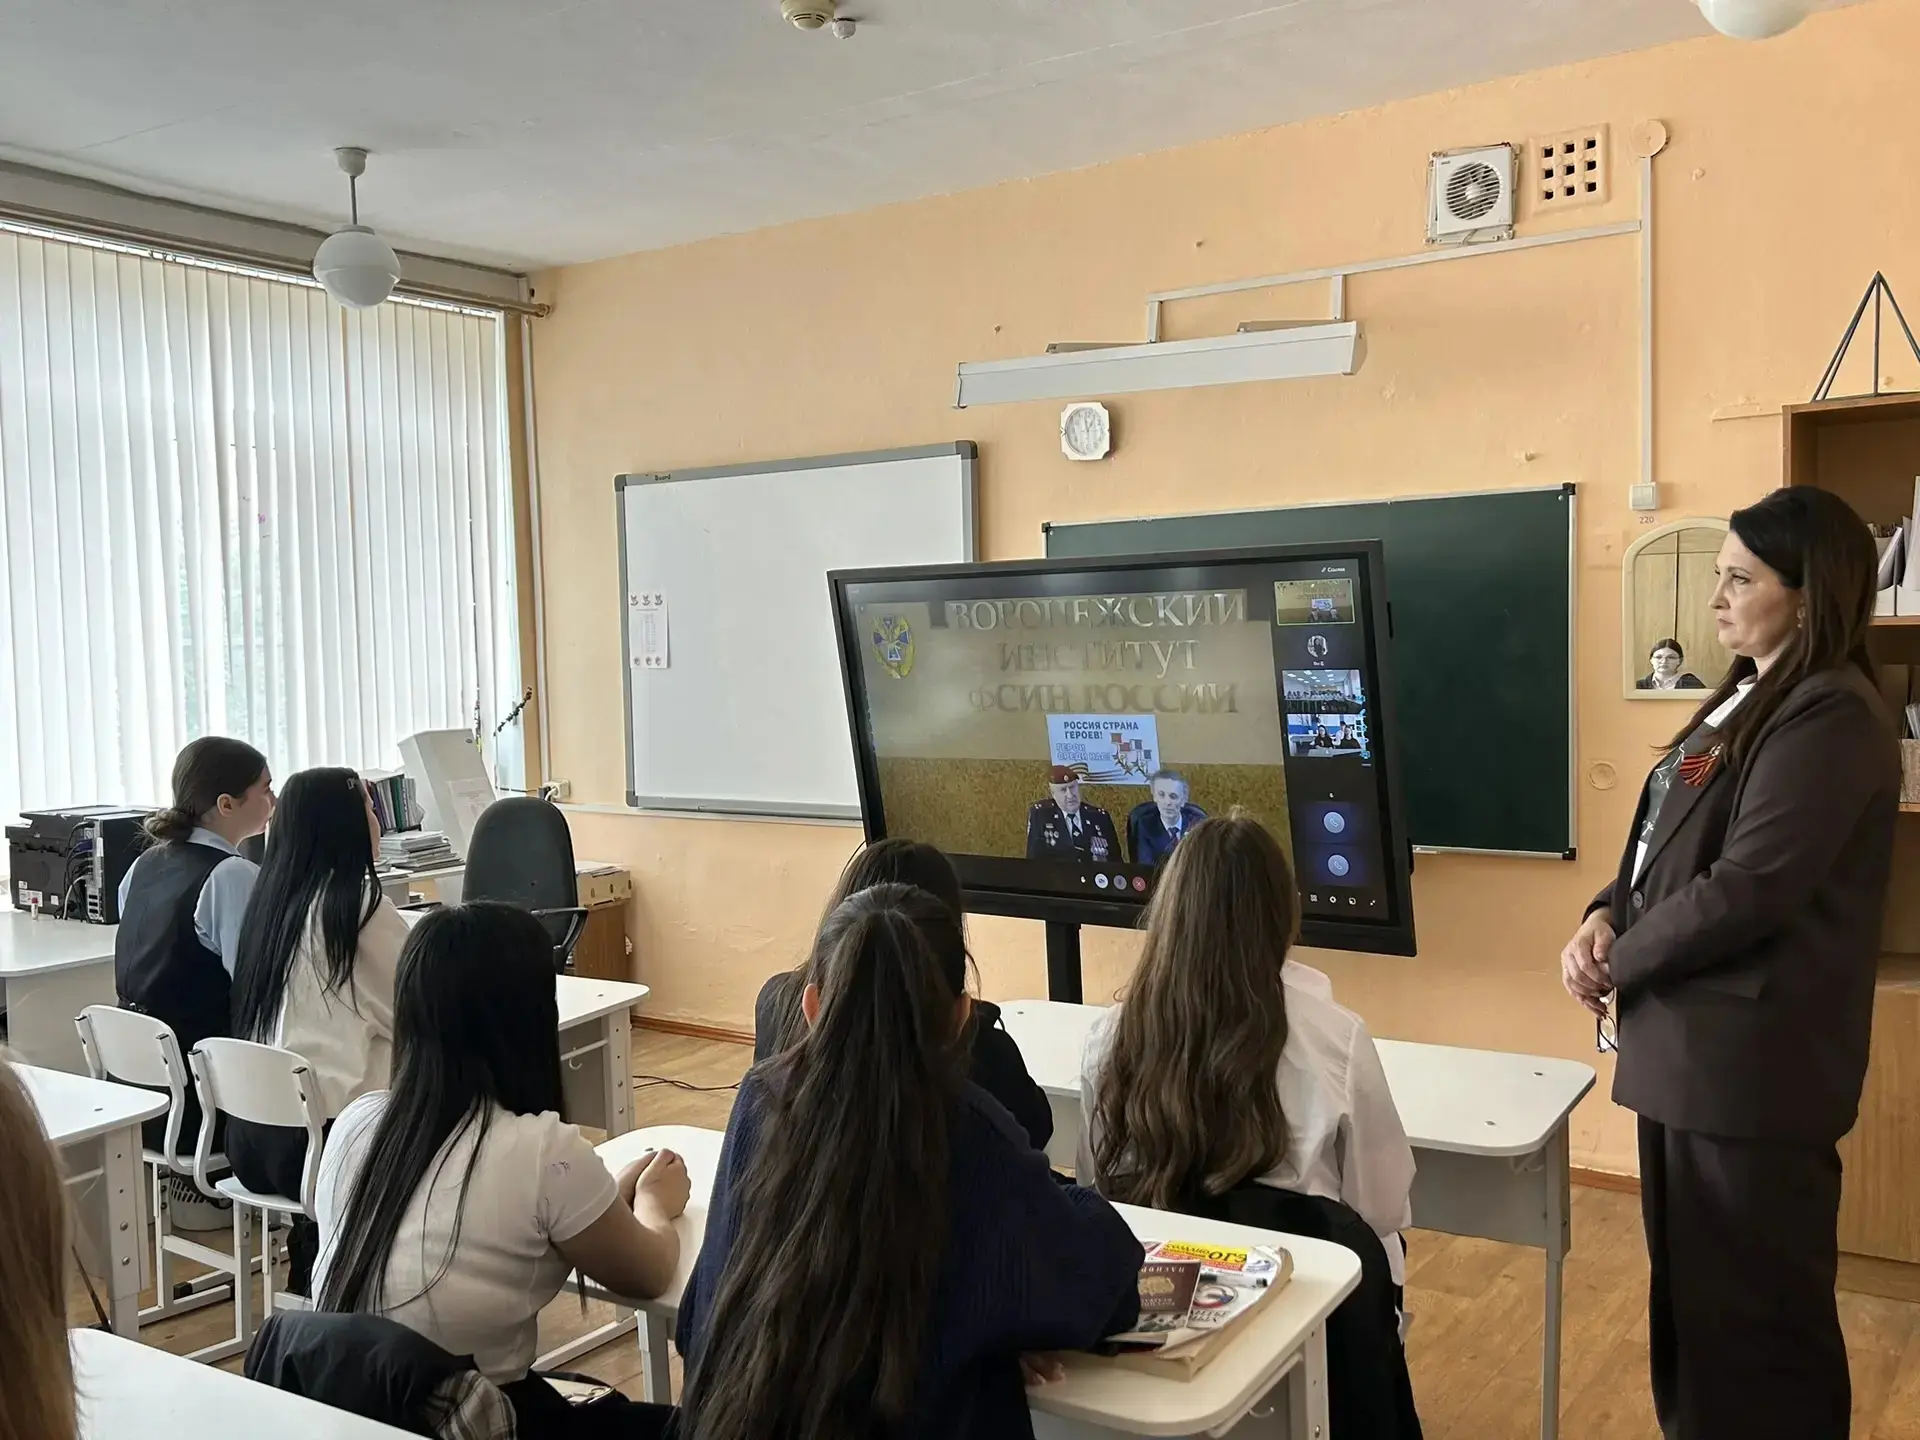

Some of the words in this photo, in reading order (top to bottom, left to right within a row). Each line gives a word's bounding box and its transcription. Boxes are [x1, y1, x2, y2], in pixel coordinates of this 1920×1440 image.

[1639, 516, 1655, 524] 220
[998, 639, 1200, 678] ИНСТИТУТ
[969, 683, 1071, 713] ФСИН
[1083, 682, 1240, 713] РОССИИ
[1063, 721, 1101, 730] РОССИЯ
[1102, 721, 1139, 730] СТРАНА
[1064, 731, 1103, 740] ГЕРОЕВ!
[1055, 742, 1086, 752] ГЕРОИ
[1208, 1251, 1248, 1263] ОГЭ
